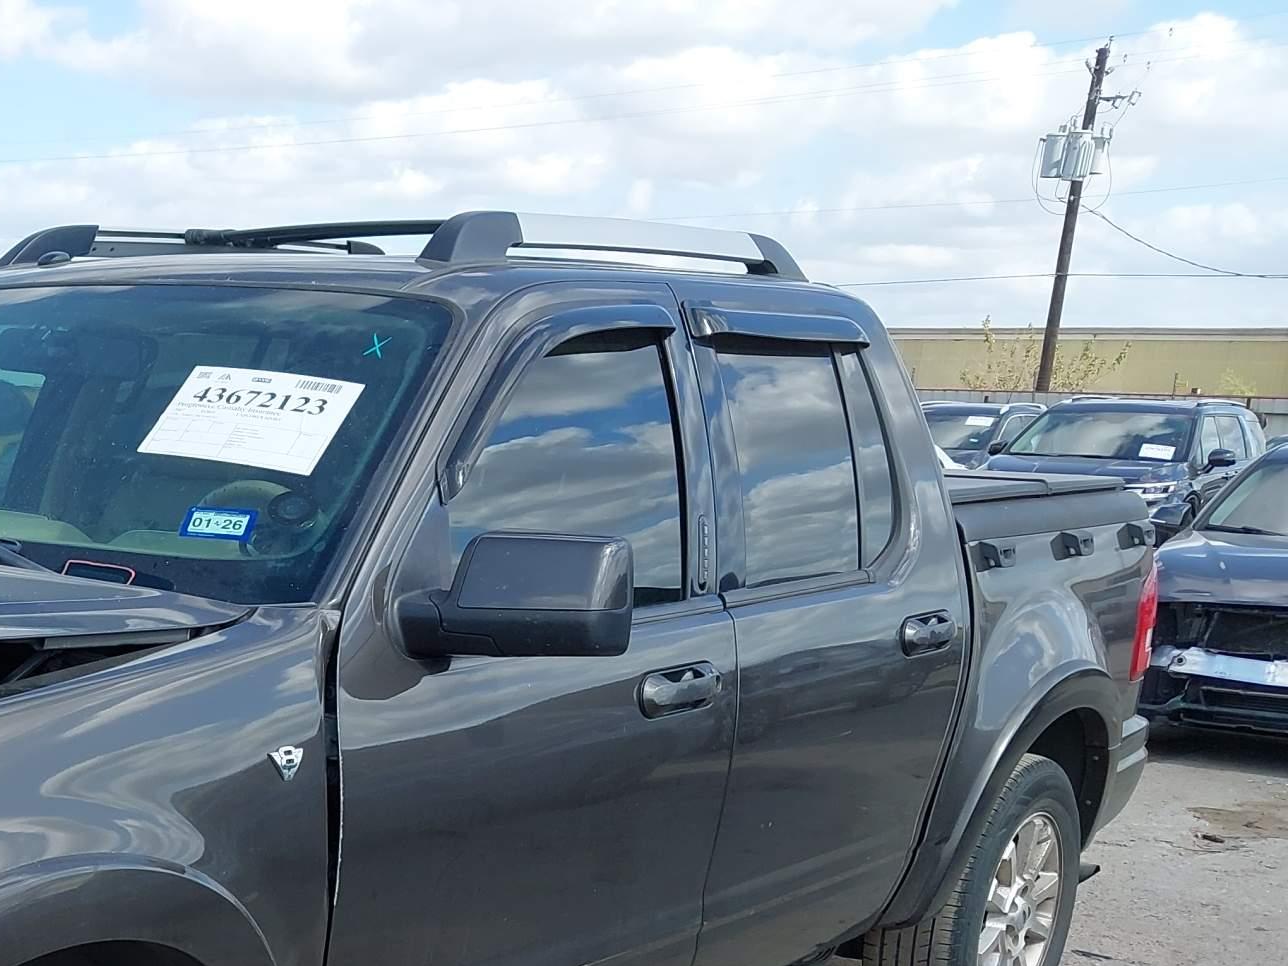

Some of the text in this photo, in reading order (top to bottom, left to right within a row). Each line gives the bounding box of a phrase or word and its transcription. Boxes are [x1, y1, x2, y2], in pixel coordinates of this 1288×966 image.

[193, 386, 328, 415] 43672123
[192, 517, 243, 531] 01 26
